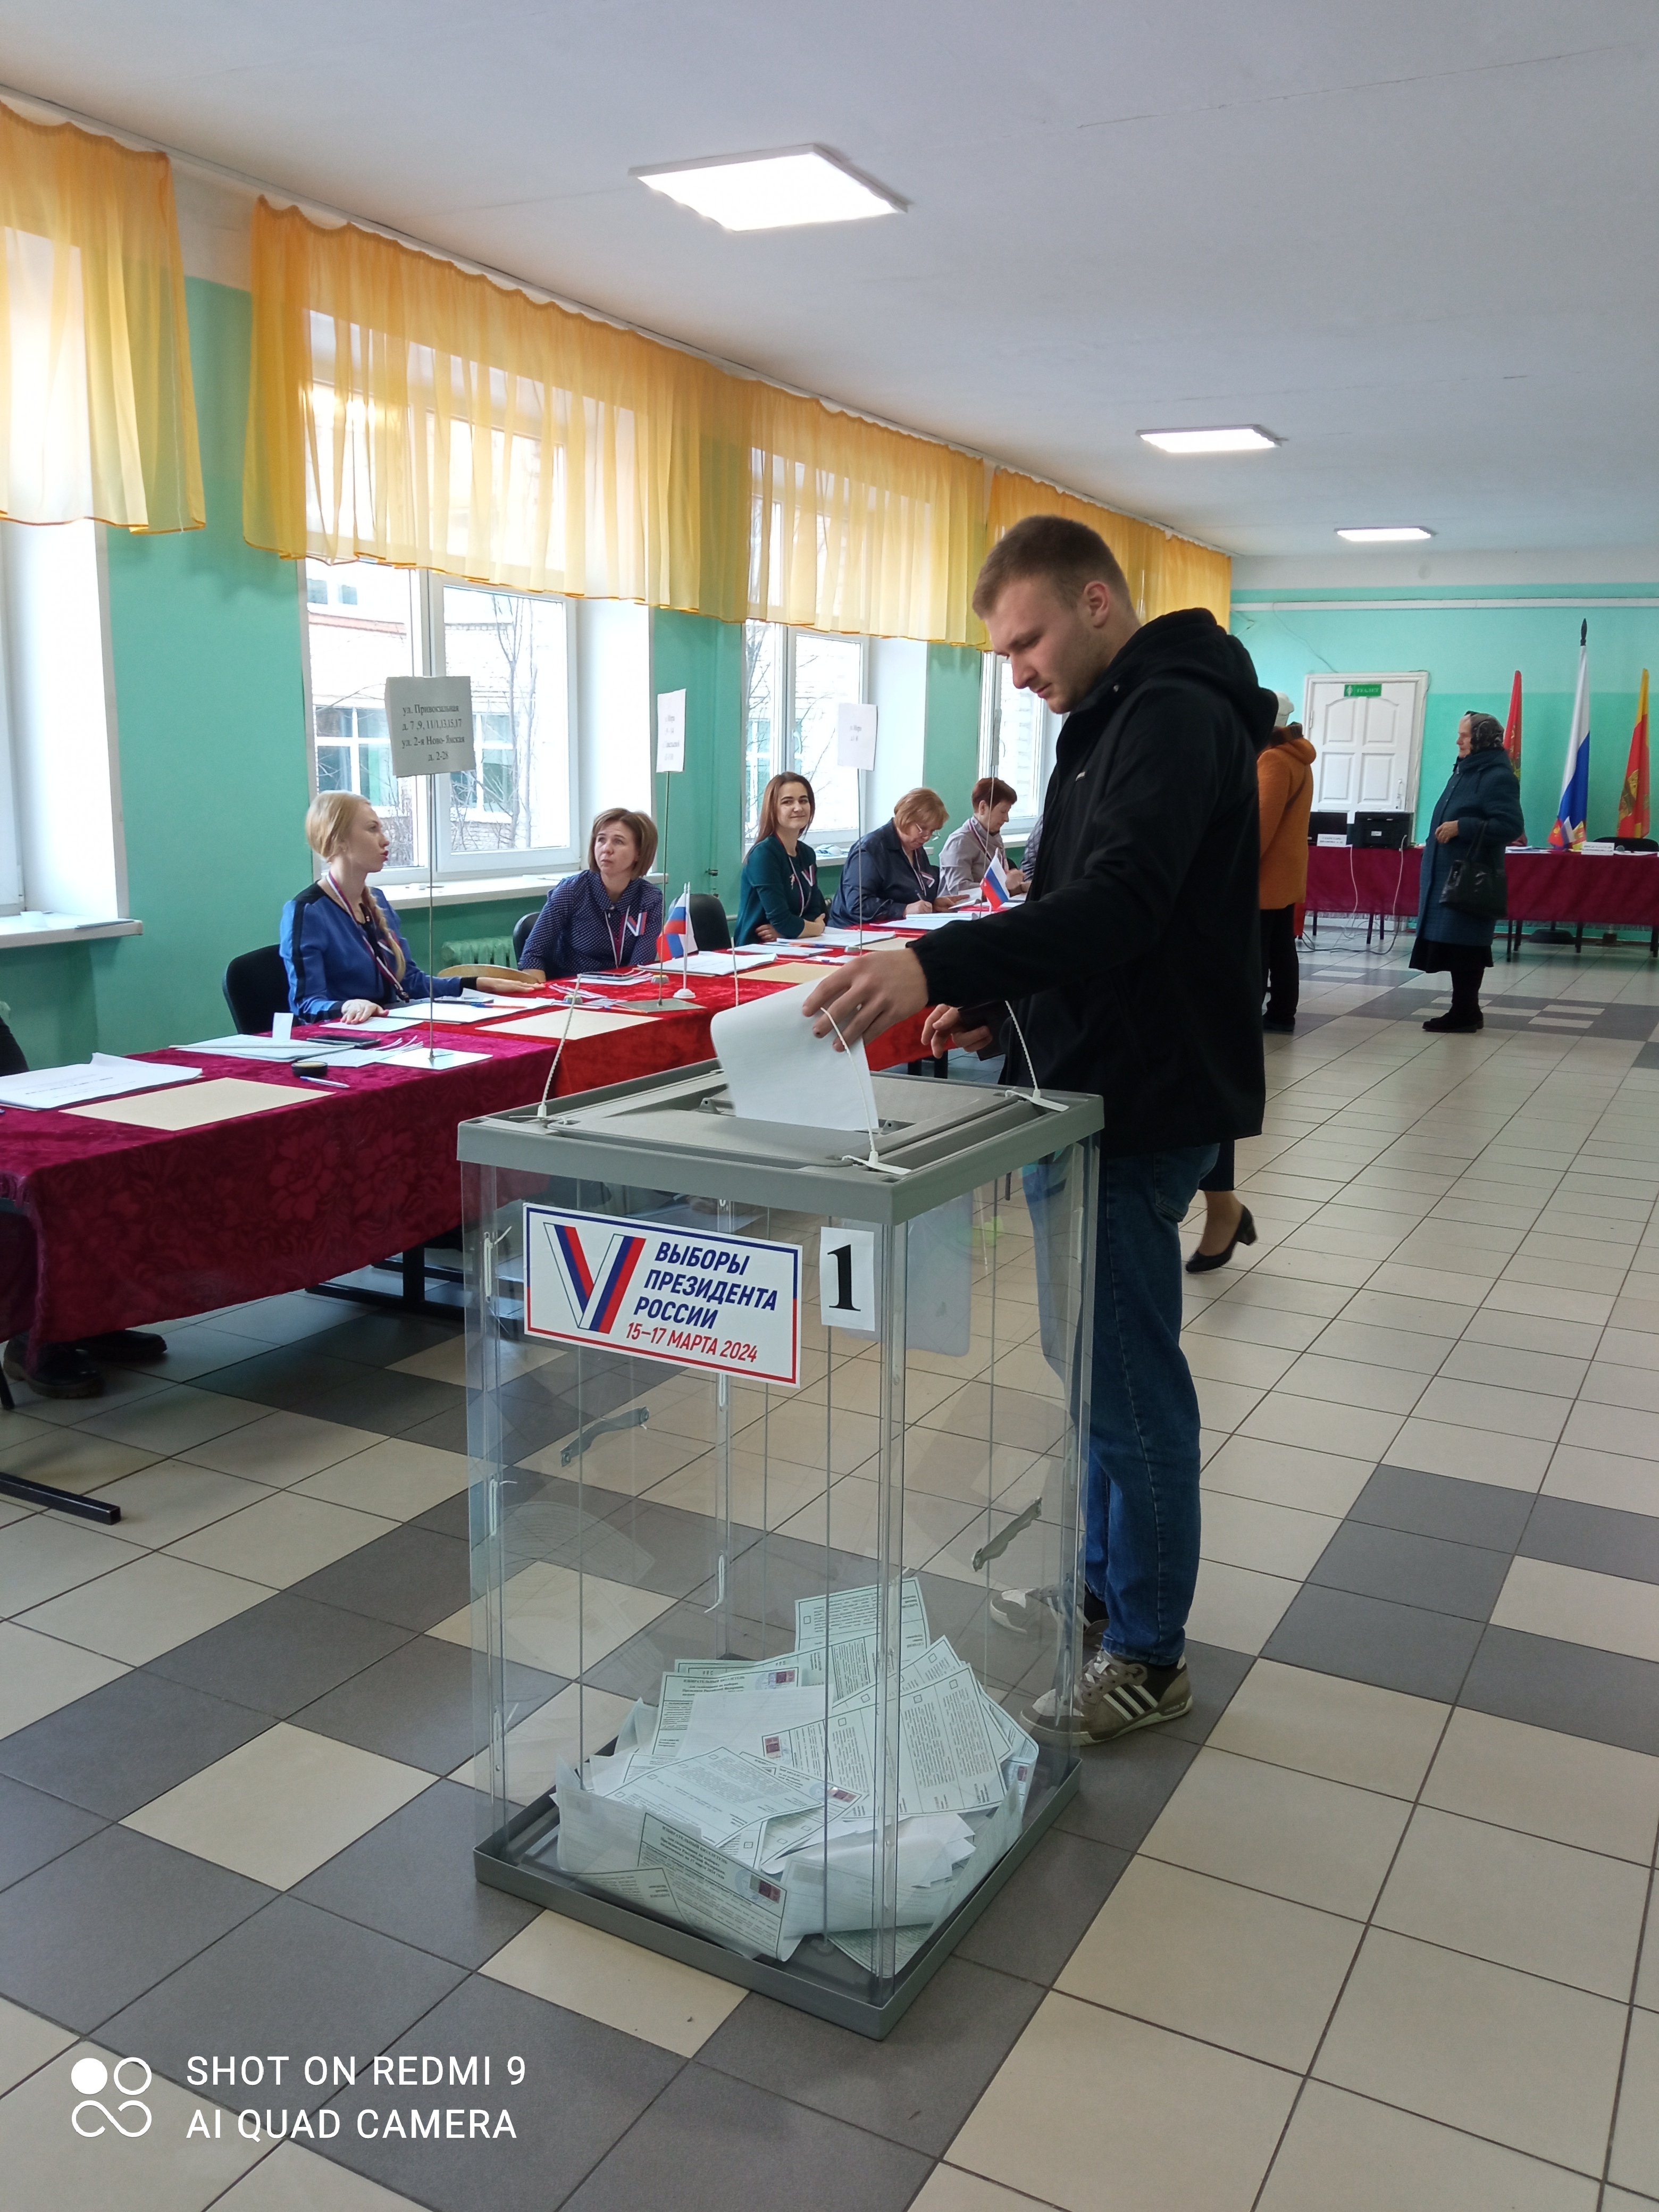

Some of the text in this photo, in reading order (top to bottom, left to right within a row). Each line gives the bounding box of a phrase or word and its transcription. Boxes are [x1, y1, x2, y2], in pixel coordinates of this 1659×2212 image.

[403, 705, 459, 716] ул. Привокзальная
[401, 740, 412, 749] ул.
[414, 737, 424, 746] 2-я
[655, 1242, 750, 1276] ВЫБОРЫ
[644, 1269, 778, 1311] ПРЕЗИДЕНТА
[827, 1244, 861, 1312] 1
[633, 1296, 718, 1329] РОССИИ
[667, 1334, 718, 1356] МАРТА
[720, 1340, 758, 1363] 2024
